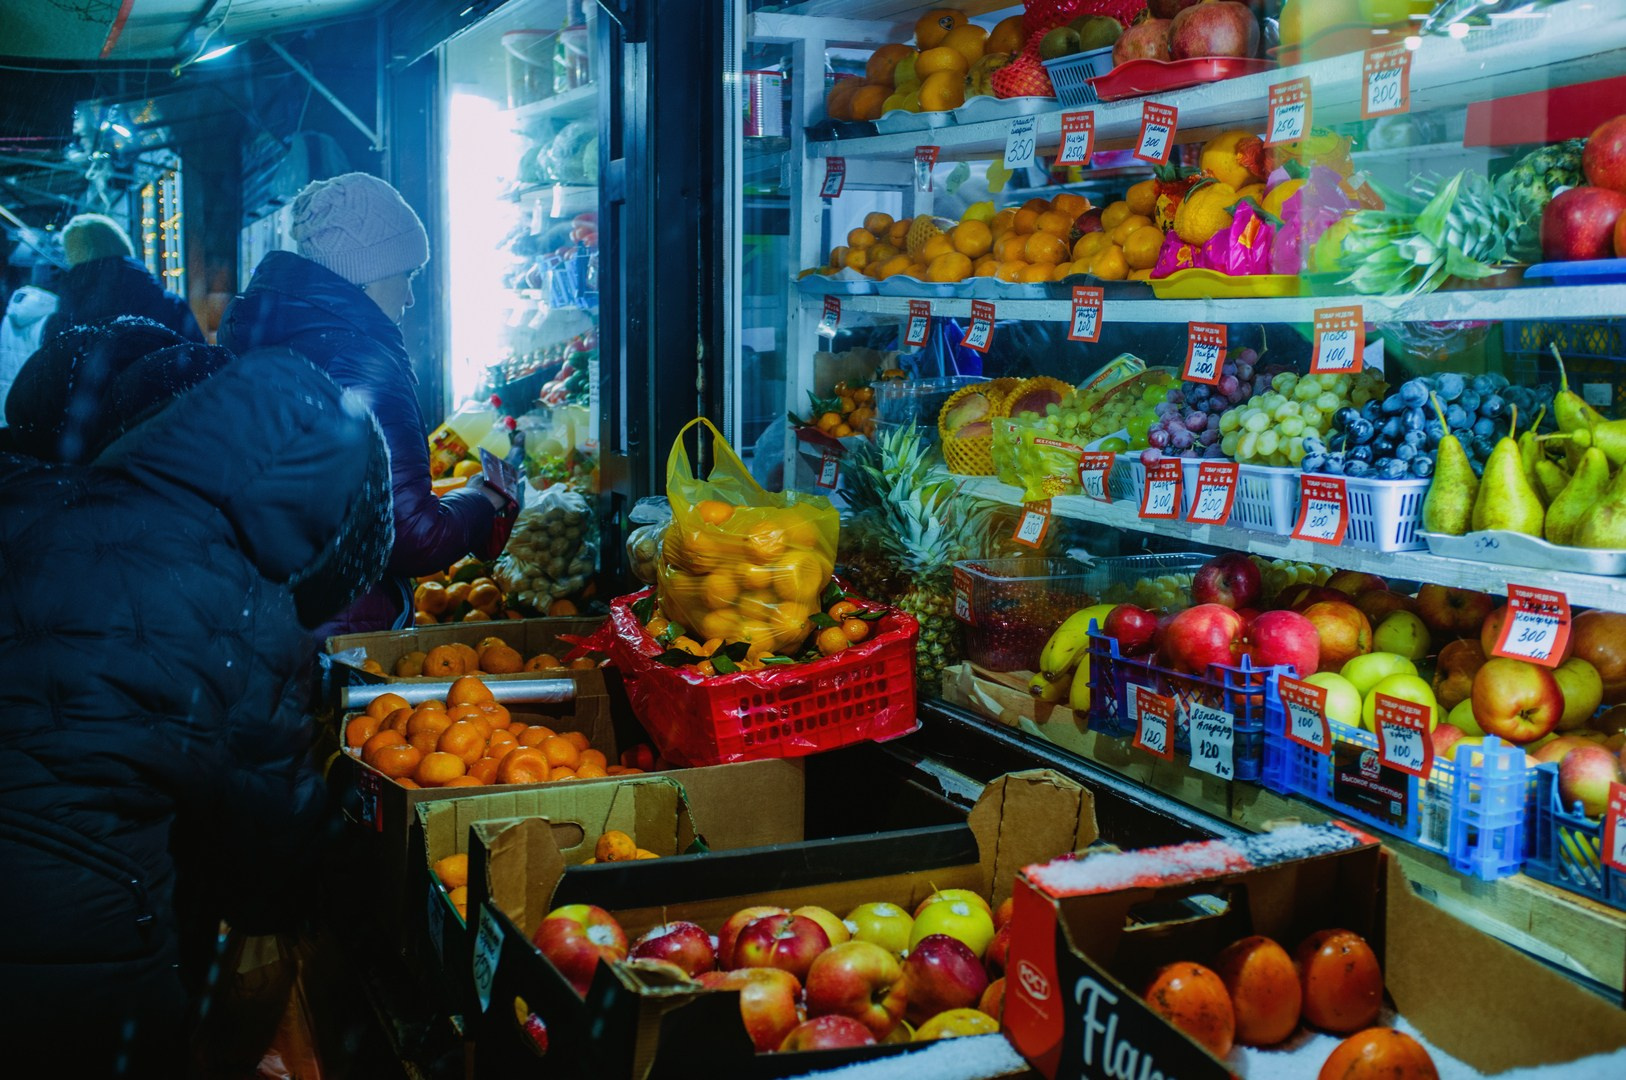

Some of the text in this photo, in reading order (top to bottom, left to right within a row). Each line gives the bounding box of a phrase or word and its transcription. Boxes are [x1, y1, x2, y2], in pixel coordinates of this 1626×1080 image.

[1372, 81, 1398, 104] 200
[1274, 117, 1295, 134] 250
[1143, 137, 1160, 148] 300
[1007, 138, 1034, 163] 350
[1065, 145, 1082, 160] 250
[1325, 346, 1346, 363] 100
[1194, 362, 1213, 374] 200
[1153, 493, 1171, 509] 300
[1201, 498, 1222, 513] 300
[1310, 515, 1328, 528] 300
[1515, 589, 1559, 603] ТОВАР НЕДЕЛИ
[1517, 627, 1547, 643] 300
[1191, 708, 1226, 724] Яблоко
[1297, 716, 1314, 729] 100
[1144, 728, 1161, 745] 120
[1200, 739, 1219, 759] 120
[1393, 745, 1411, 758] 100
[1341, 772, 1369, 787] Высокое
